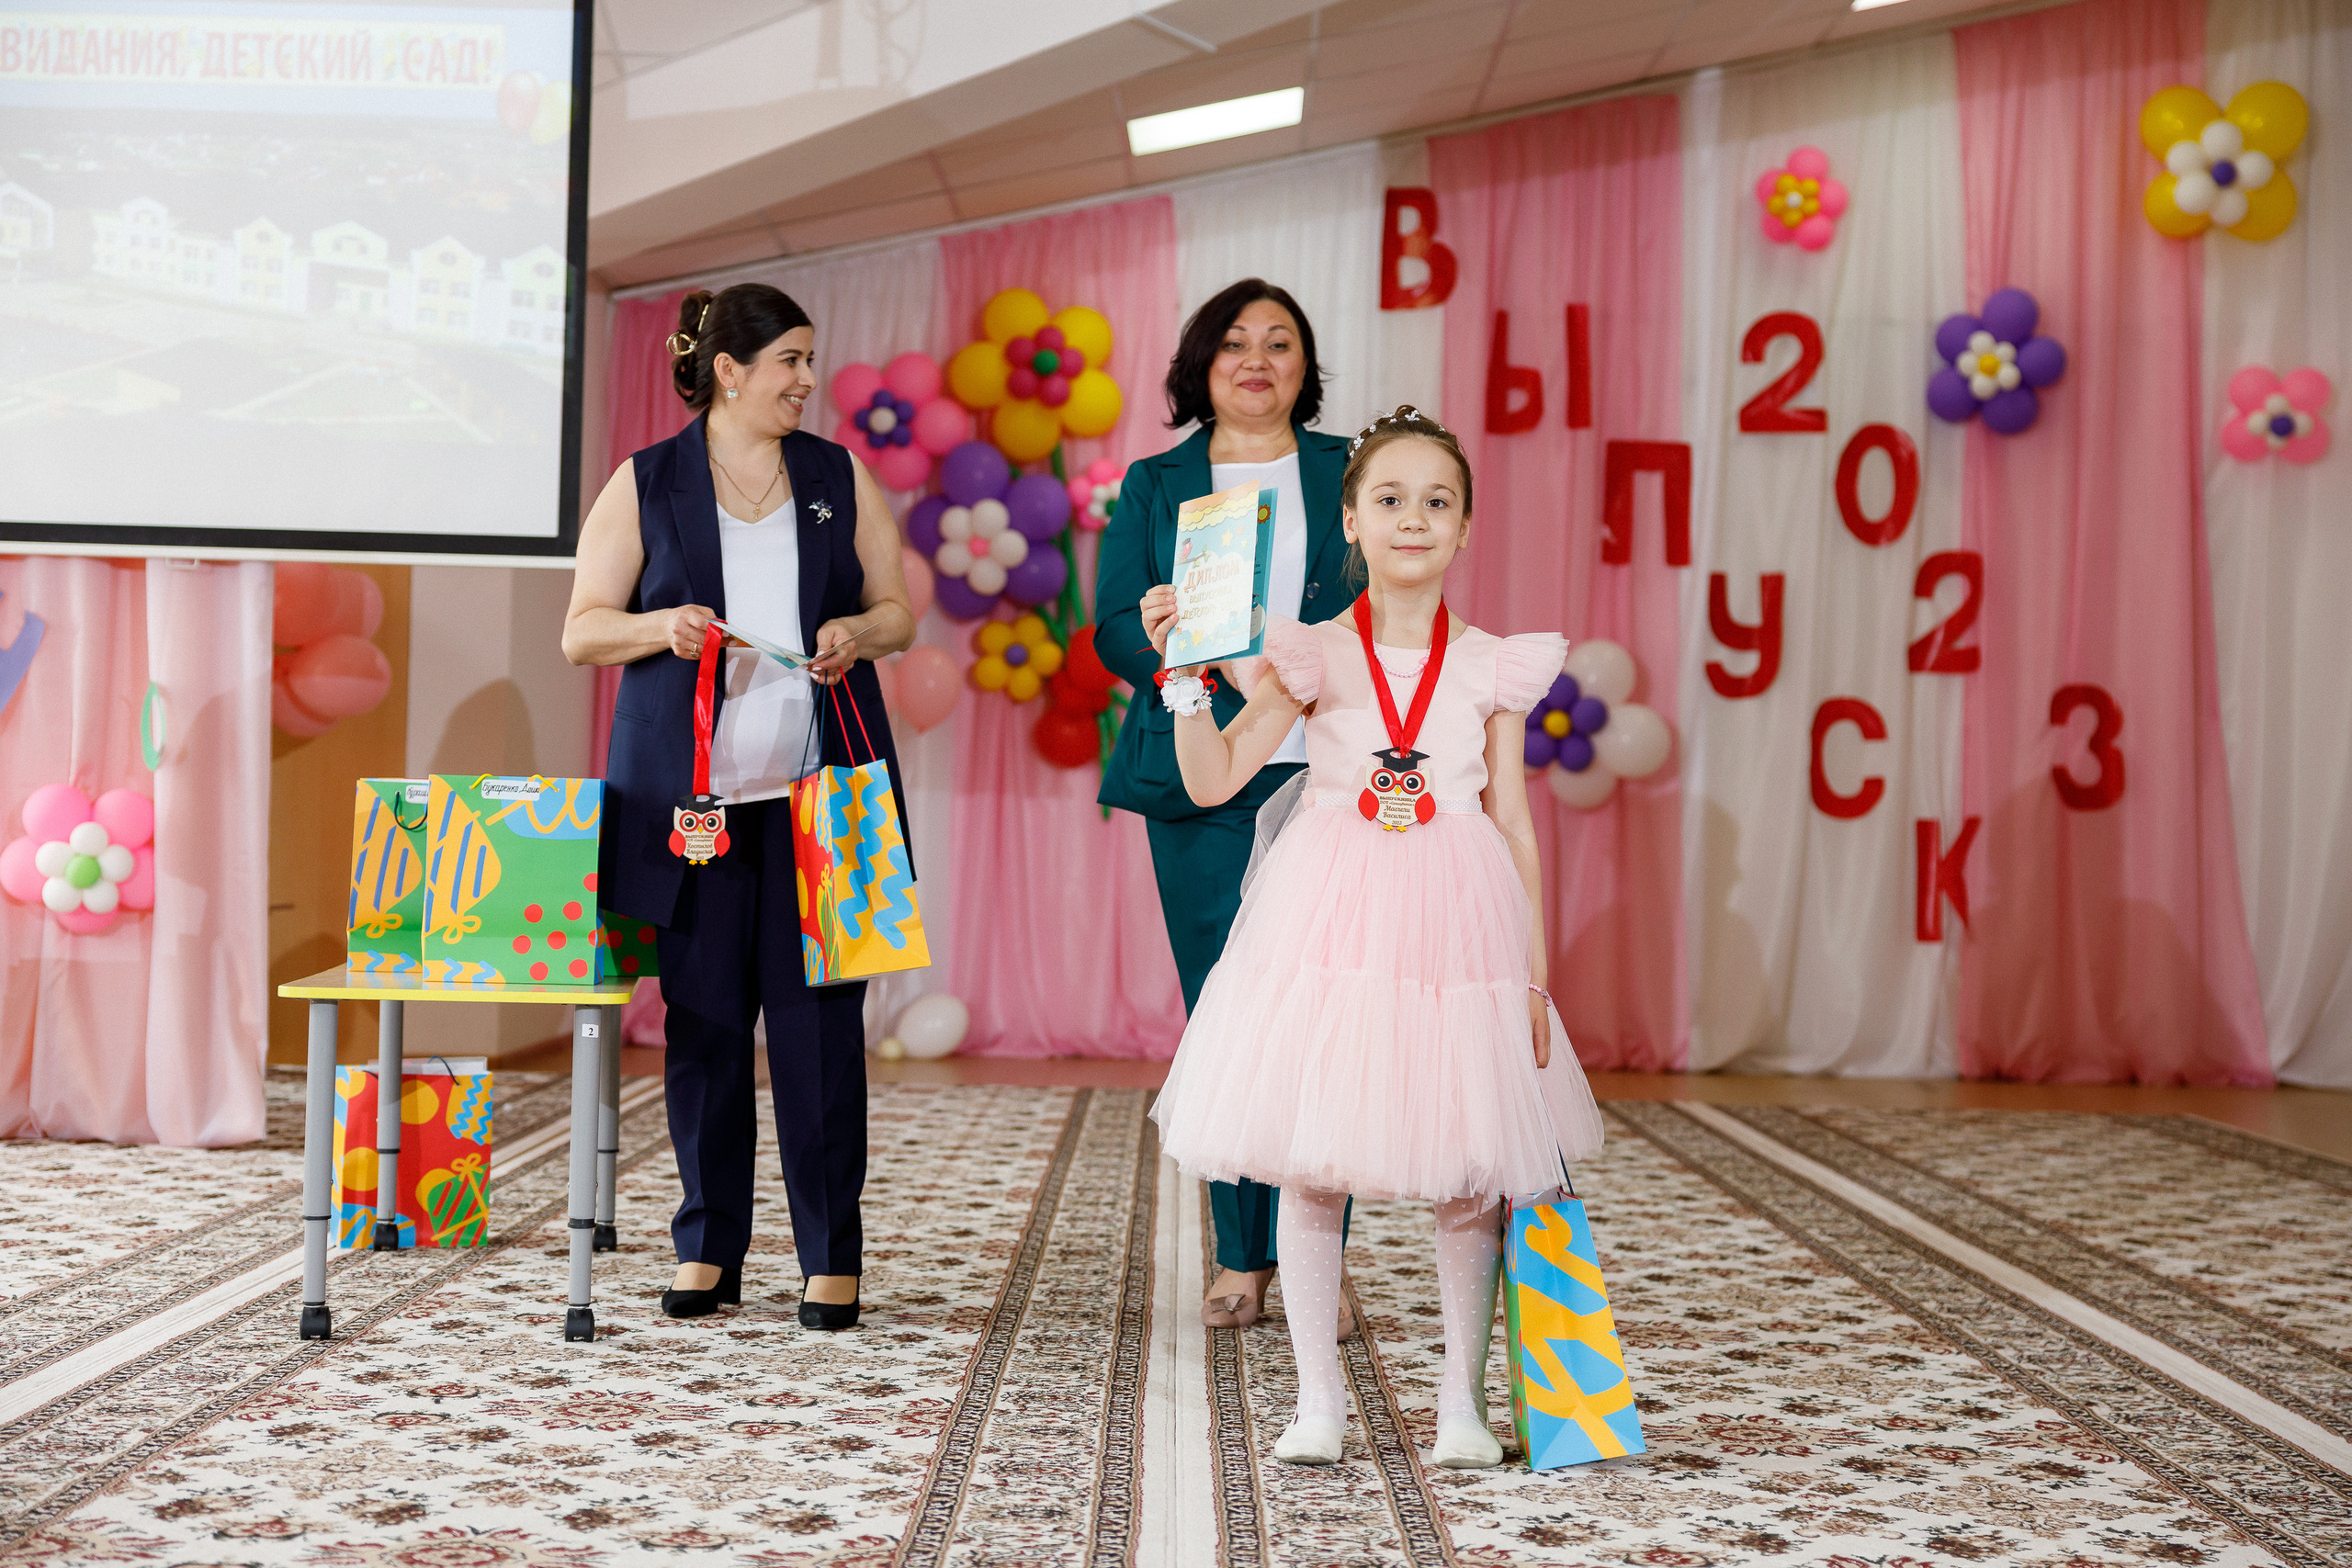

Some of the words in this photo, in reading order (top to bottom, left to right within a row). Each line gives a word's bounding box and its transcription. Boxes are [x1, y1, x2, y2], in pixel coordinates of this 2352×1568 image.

[200, 28, 370, 81] ДЕТСКИЙ
[401, 36, 493, 85] САД!
[1183, 559, 1240, 593] ДИПЛОМ
[588, 1027, 594, 1036] 2
